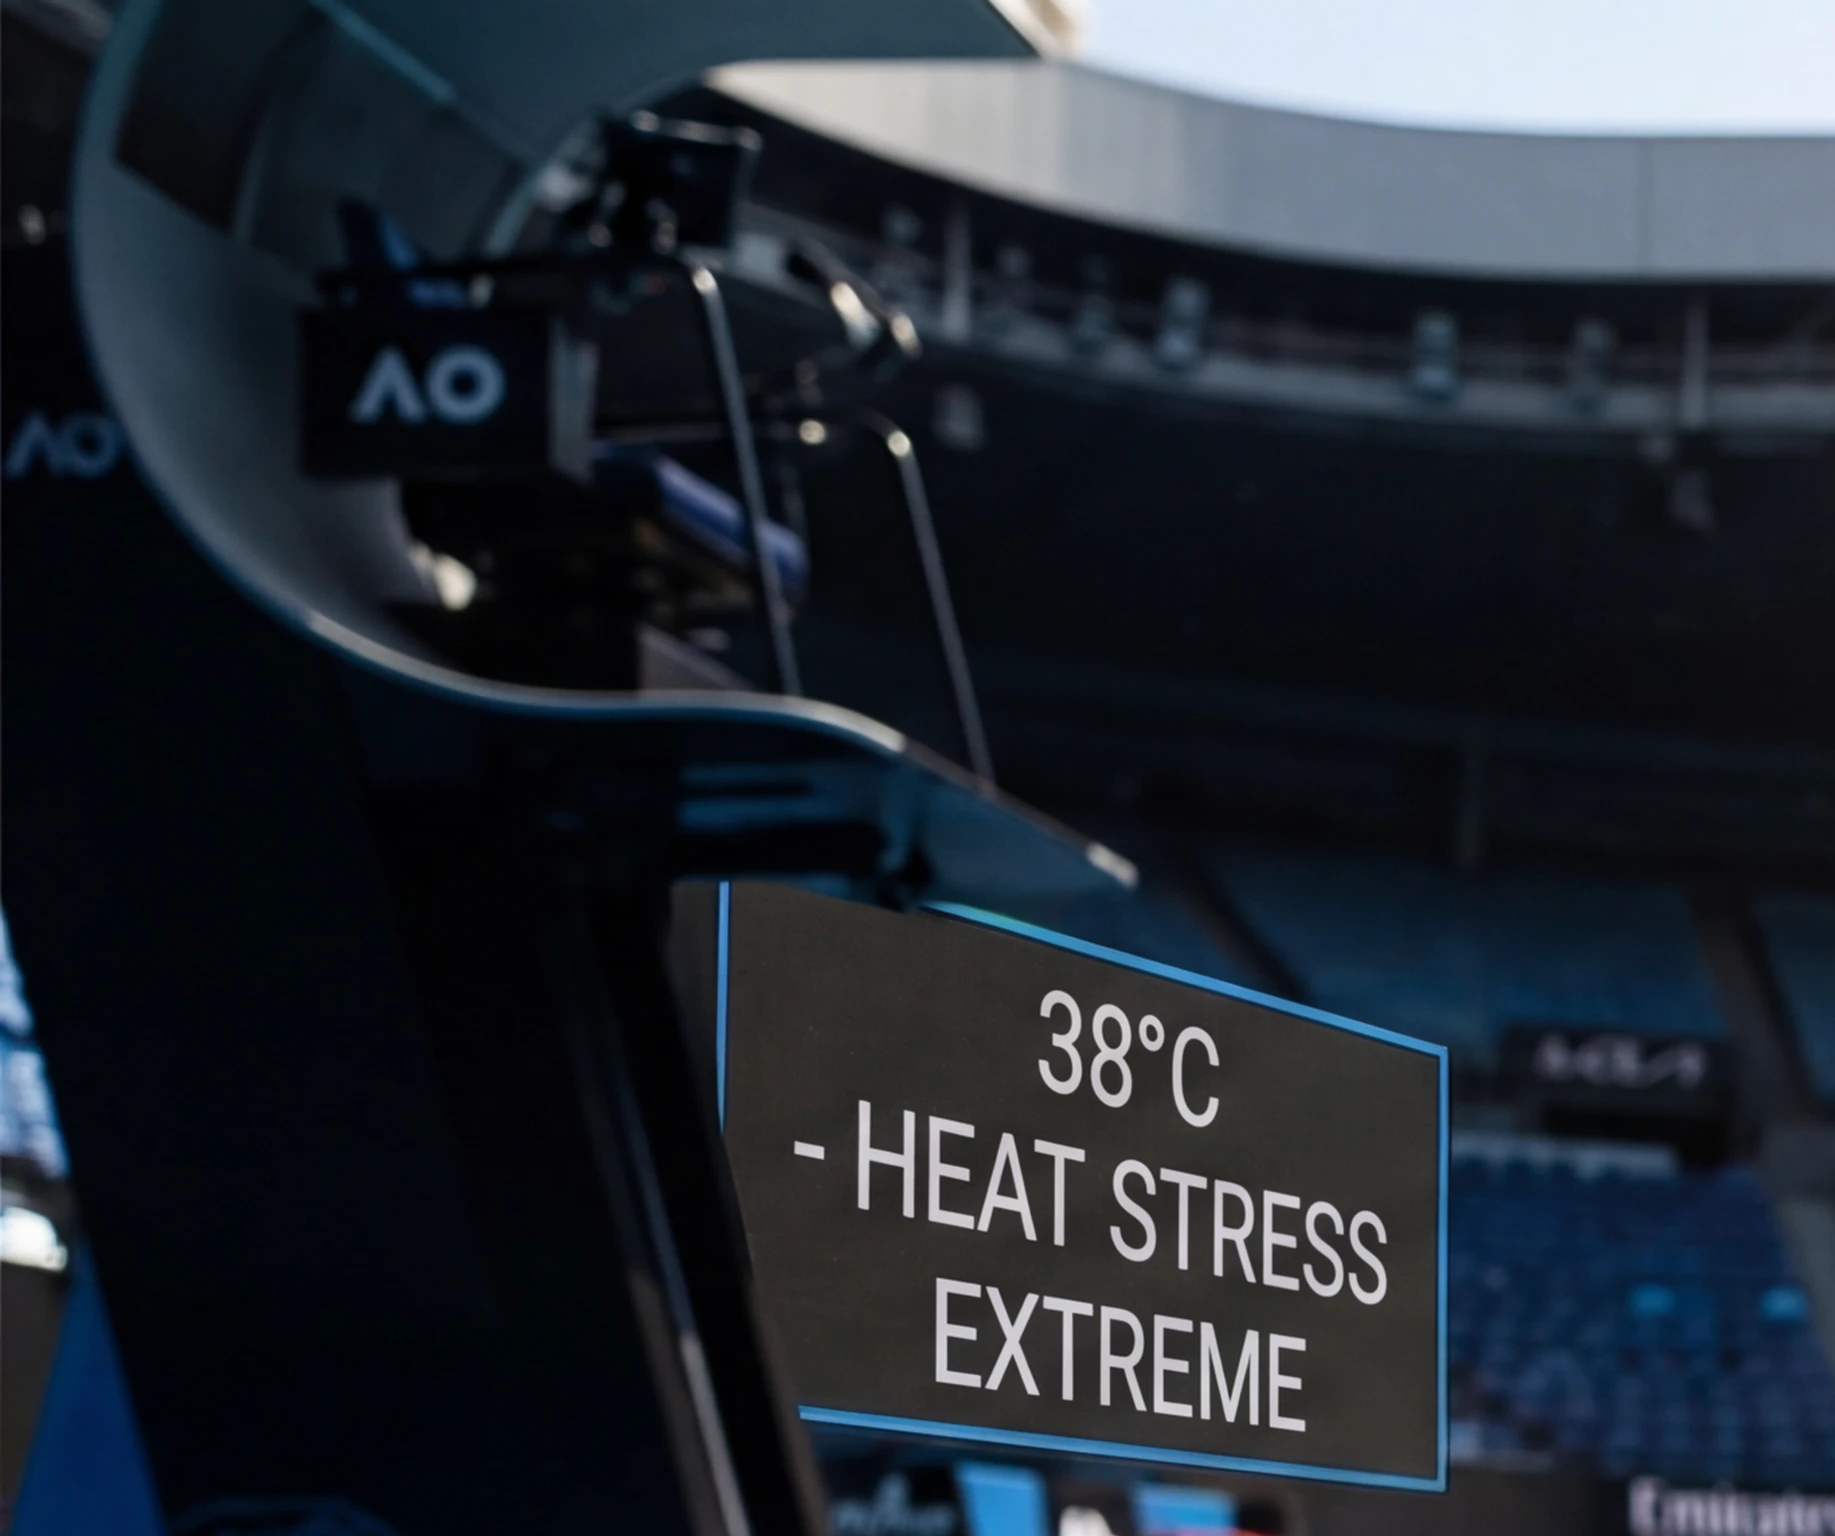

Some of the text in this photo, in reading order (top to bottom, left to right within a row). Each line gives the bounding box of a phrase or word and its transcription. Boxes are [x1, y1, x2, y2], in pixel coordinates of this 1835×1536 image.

[1038, 989, 1220, 1128] 38°C
[857, 1099, 1086, 1247] HEAT
[1109, 1159, 1388, 1305] STRESS
[935, 1277, 1307, 1432] EXTREME
